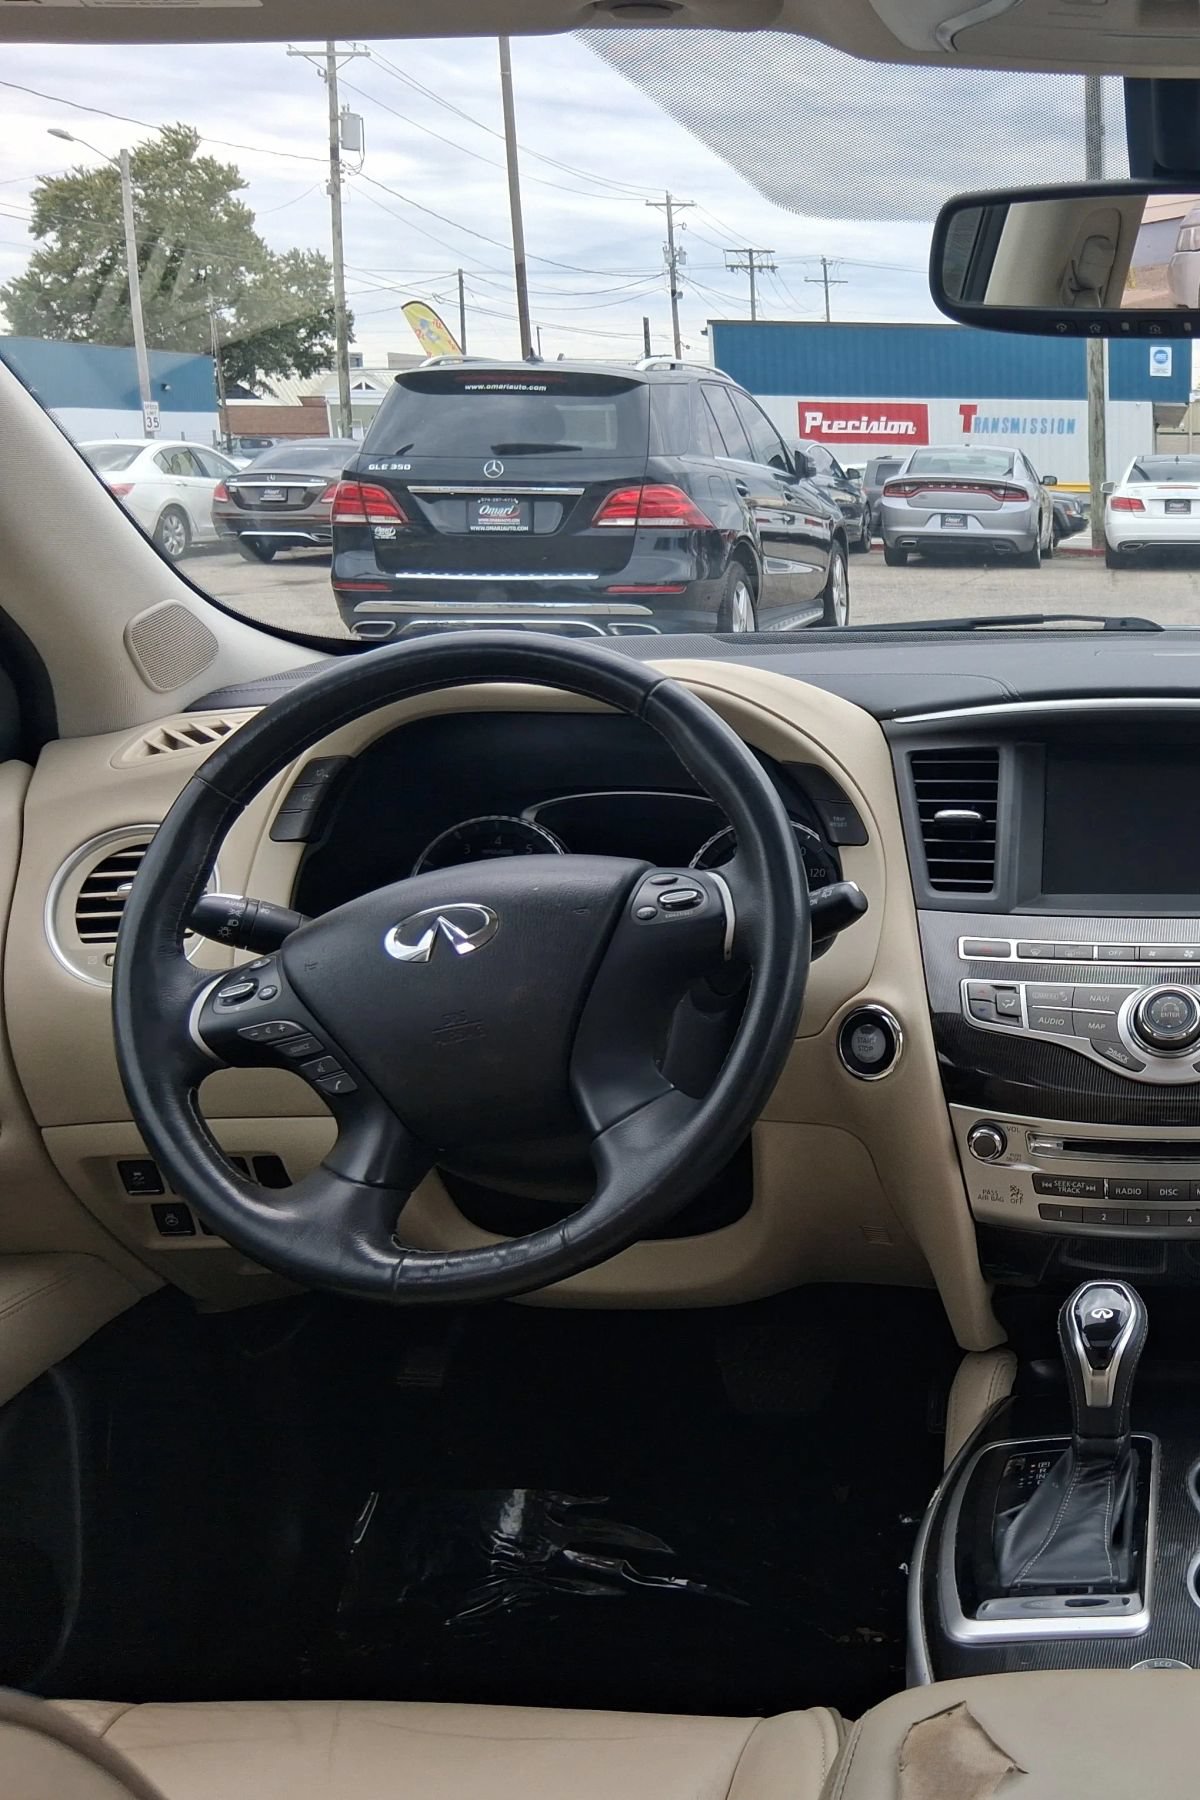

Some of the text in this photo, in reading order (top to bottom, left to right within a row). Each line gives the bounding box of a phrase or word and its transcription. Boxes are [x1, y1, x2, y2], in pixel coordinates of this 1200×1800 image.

[146, 416, 159, 428] 35
[805, 411, 916, 435] Precision
[1038, 1016, 1065, 1026] AUDIO
[1088, 1022, 1106, 1030] MAP
[1007, 1126, 1020, 1134] VOL
[1115, 1187, 1142, 1195] RADIO
[1160, 1188, 1179, 1196] DISC
[1101, 1213, 1107, 1221] 2
[1145, 1215, 1151, 1223] 3
[1187, 1215, 1193, 1223] 4
